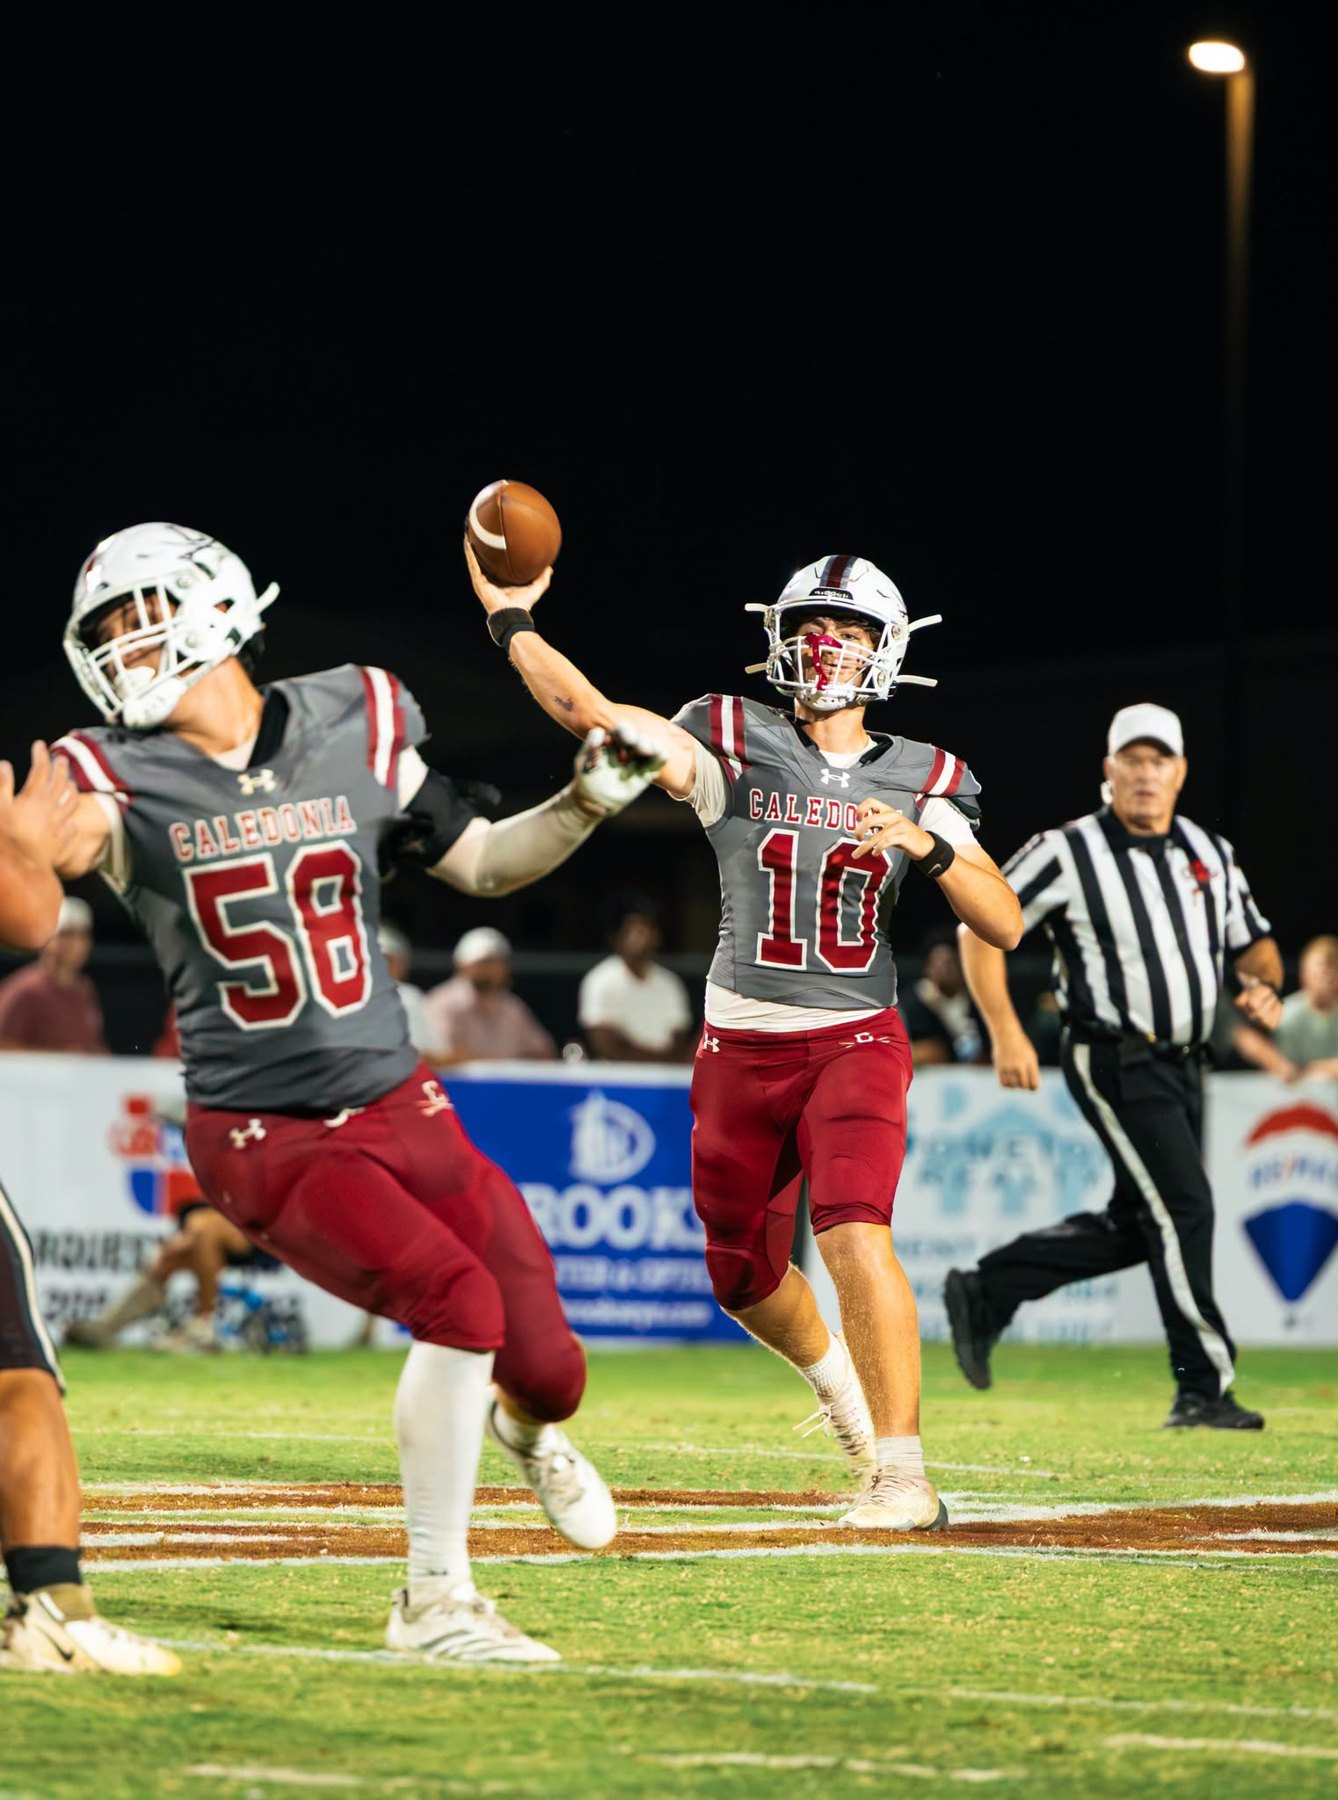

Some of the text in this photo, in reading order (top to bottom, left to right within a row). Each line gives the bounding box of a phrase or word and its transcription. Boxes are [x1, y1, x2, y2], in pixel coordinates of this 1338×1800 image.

[168, 795, 358, 861] CALEDONIA
[749, 787, 884, 836] CALEDO
[183, 839, 373, 1032] 58
[755, 827, 893, 973] 10
